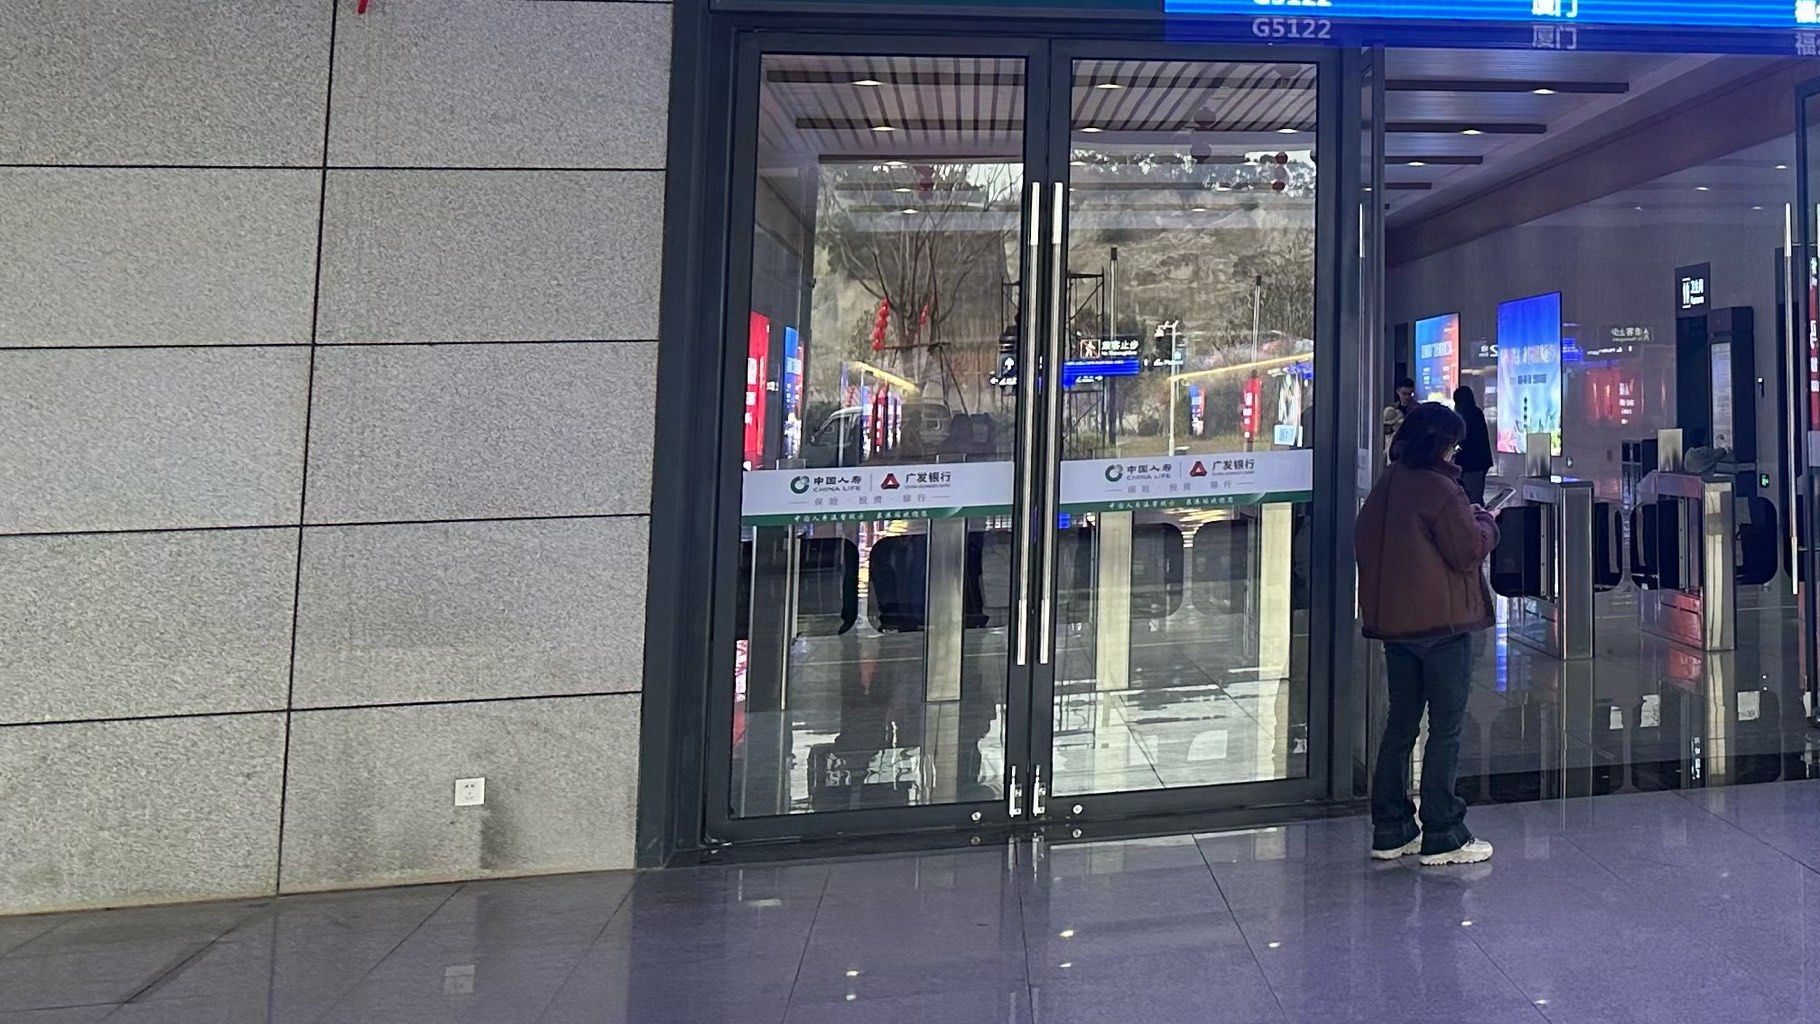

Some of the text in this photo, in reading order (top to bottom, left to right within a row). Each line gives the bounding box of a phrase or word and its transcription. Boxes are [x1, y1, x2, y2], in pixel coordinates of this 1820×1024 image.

[1252, 17, 1331, 40] G5122
[1532, 24, 1578, 50] 厦门
[1126, 463, 1172, 474] 中国人寿
[1212, 458, 1255, 470] 广发银行
[814, 475, 862, 485] 中国人寿
[905, 471, 952, 484] 广发银行
[813, 485, 840, 493] CHINA
